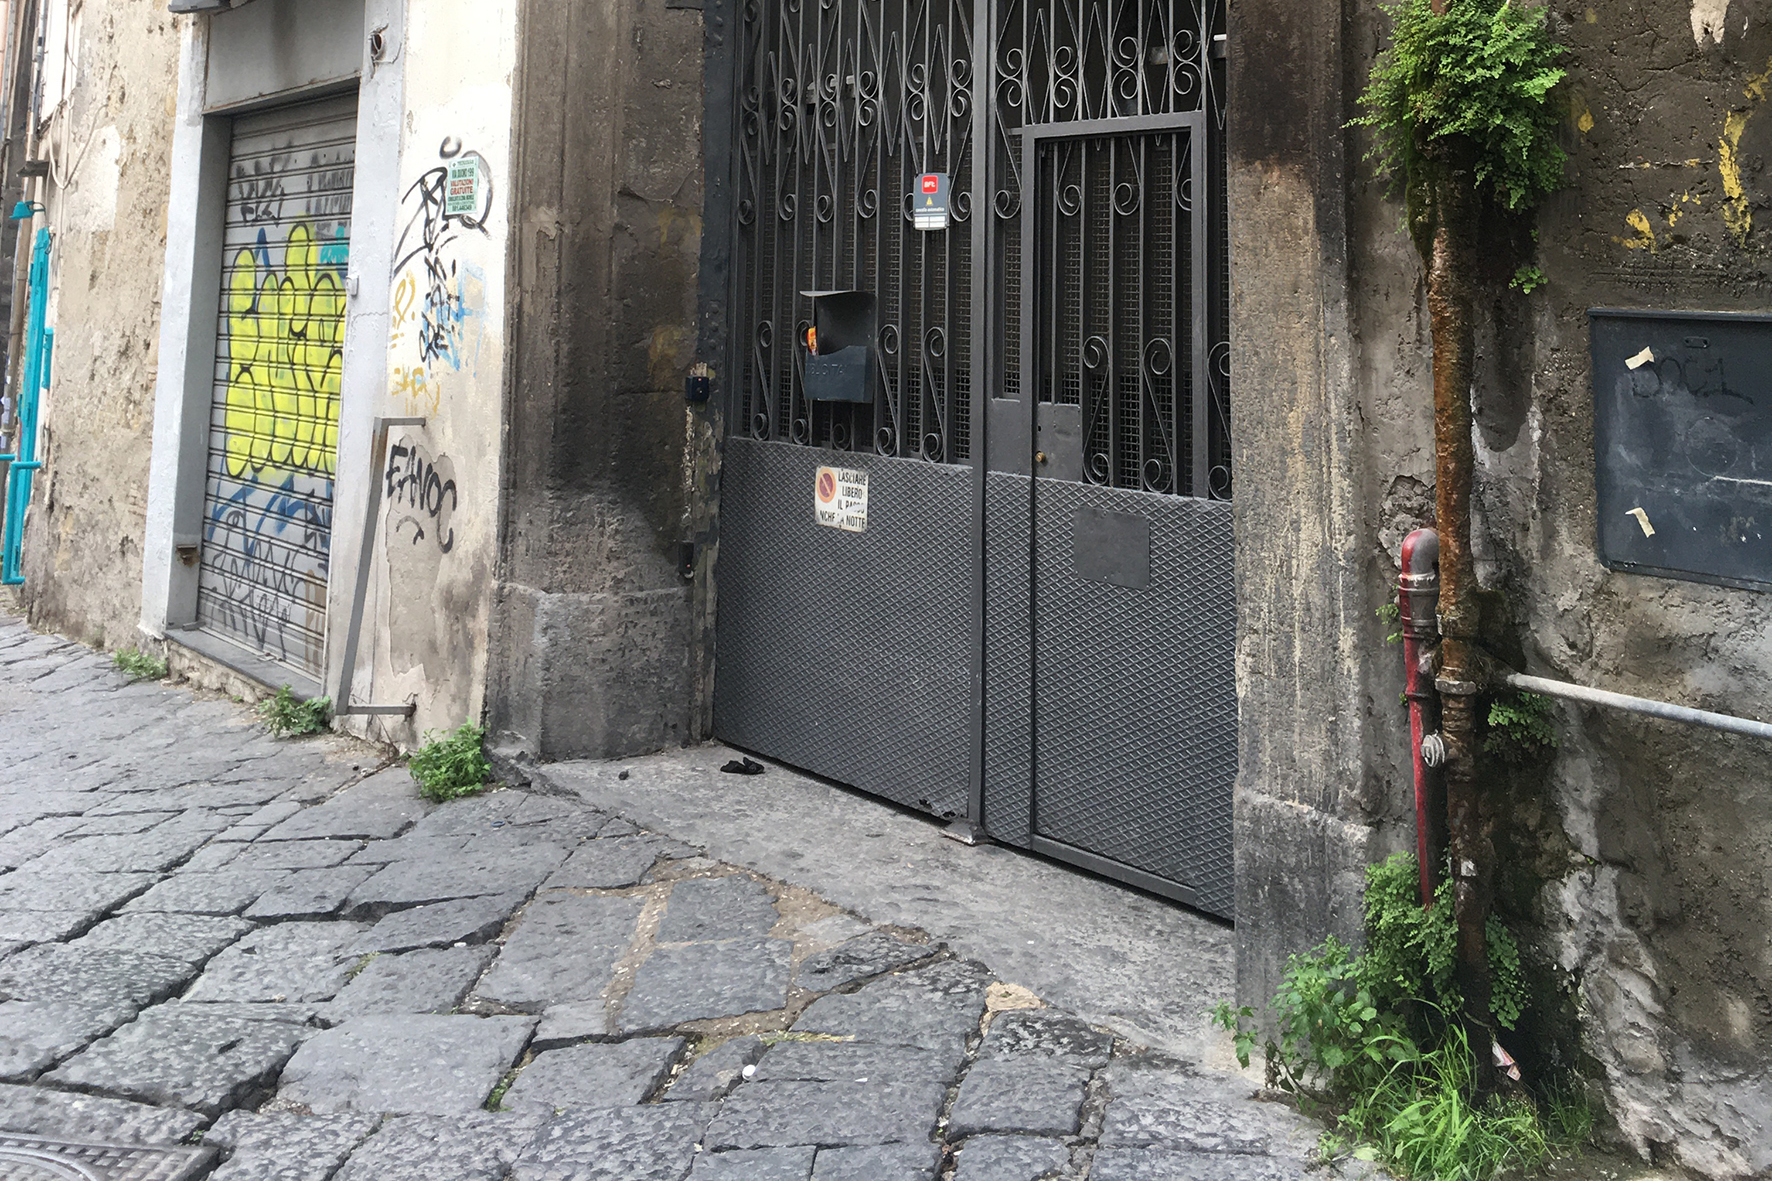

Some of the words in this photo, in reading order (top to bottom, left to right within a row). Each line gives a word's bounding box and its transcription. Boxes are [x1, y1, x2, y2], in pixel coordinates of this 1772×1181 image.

[451, 186, 473, 195] GRATUITE
[838, 471, 866, 485] LASCIARE
[842, 486, 862, 499] LIBERO
[838, 499, 843, 510] IL
[846, 515, 866, 528] NOTTE
